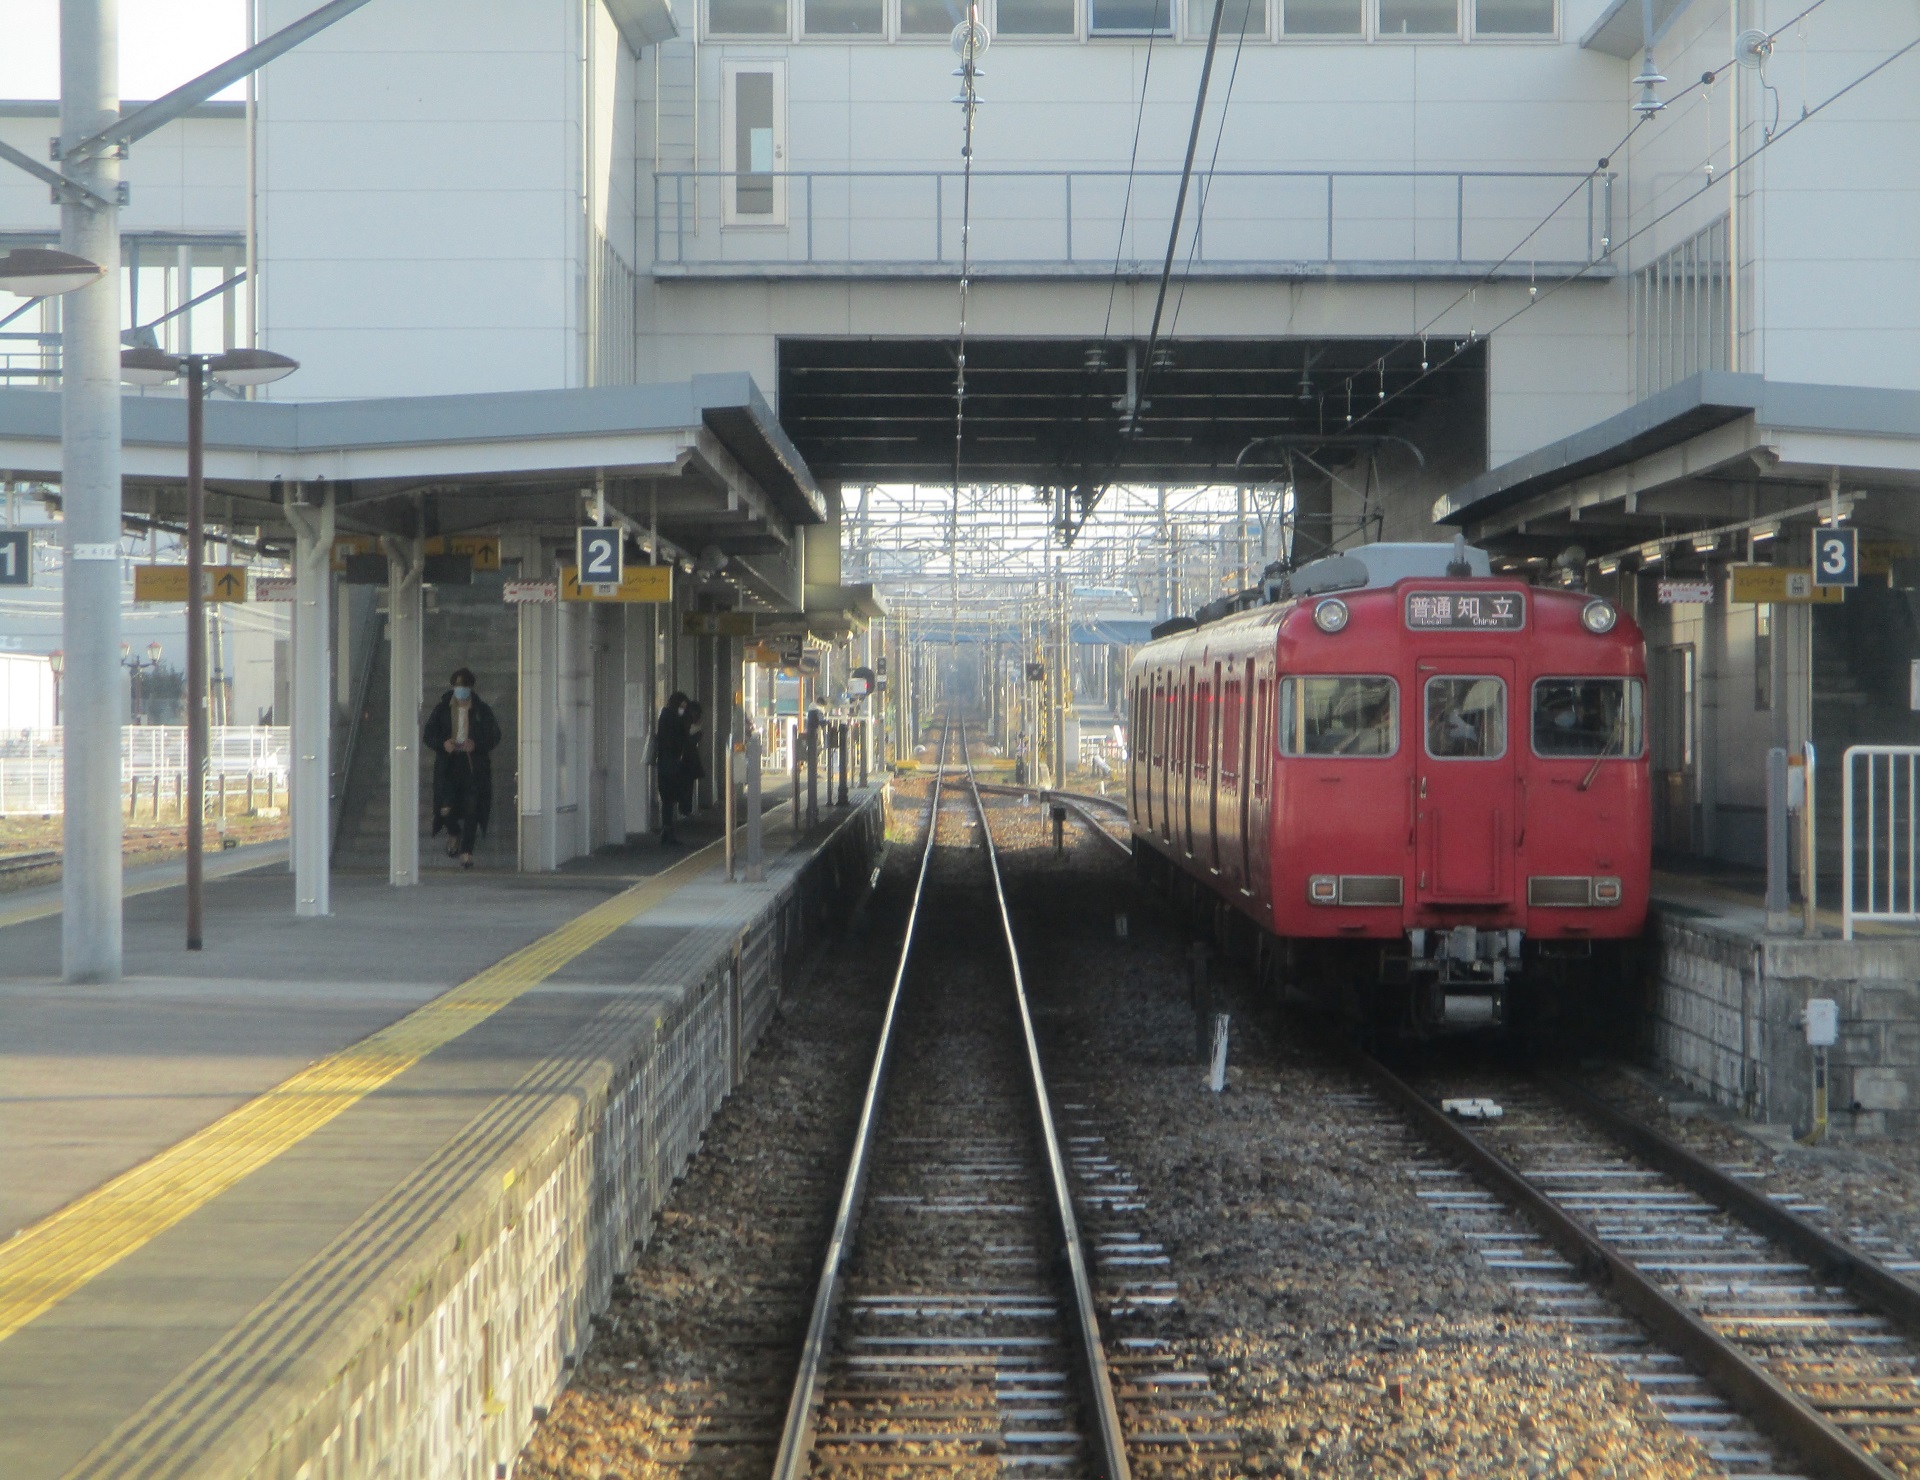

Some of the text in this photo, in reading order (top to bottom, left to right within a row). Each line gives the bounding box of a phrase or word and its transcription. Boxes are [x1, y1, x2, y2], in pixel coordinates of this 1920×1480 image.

[0, 542, 16, 576] 1
[588, 539, 612, 573] 2
[1823, 539, 1847, 574] 3
[1410, 596, 1451, 619] 普通
[1473, 618, 1498, 626] Chiryu
